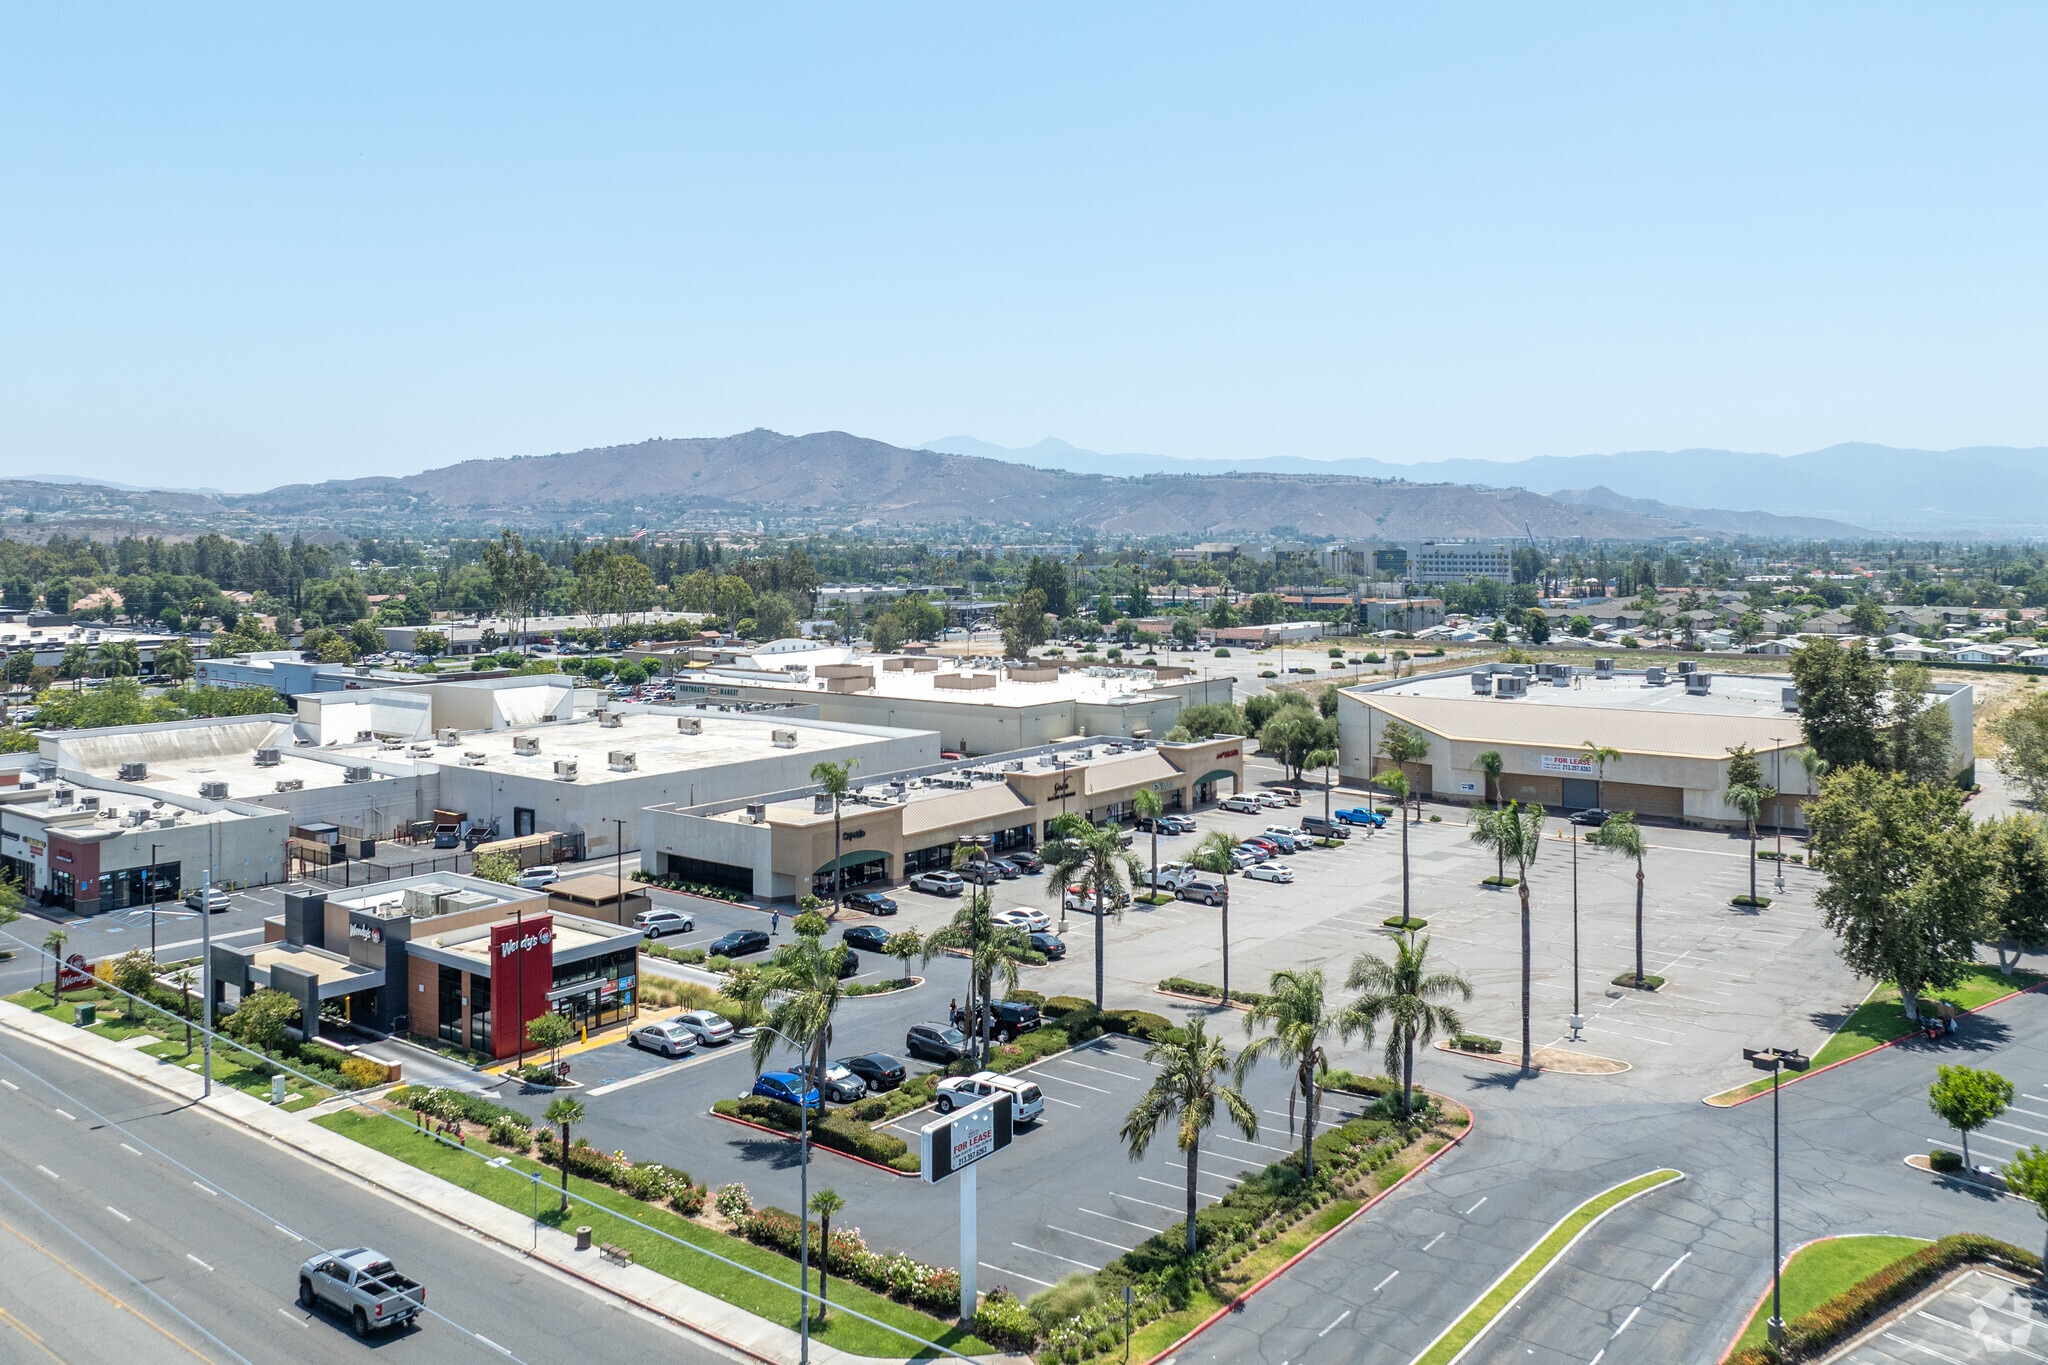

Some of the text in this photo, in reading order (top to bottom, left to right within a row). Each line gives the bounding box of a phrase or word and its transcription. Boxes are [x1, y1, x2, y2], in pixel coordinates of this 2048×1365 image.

[1570, 758, 1591, 766] LEASE
[350, 924, 371, 941] Wendy's
[953, 1141, 968, 1155] FOR
[969, 1129, 992, 1147] LEASE
